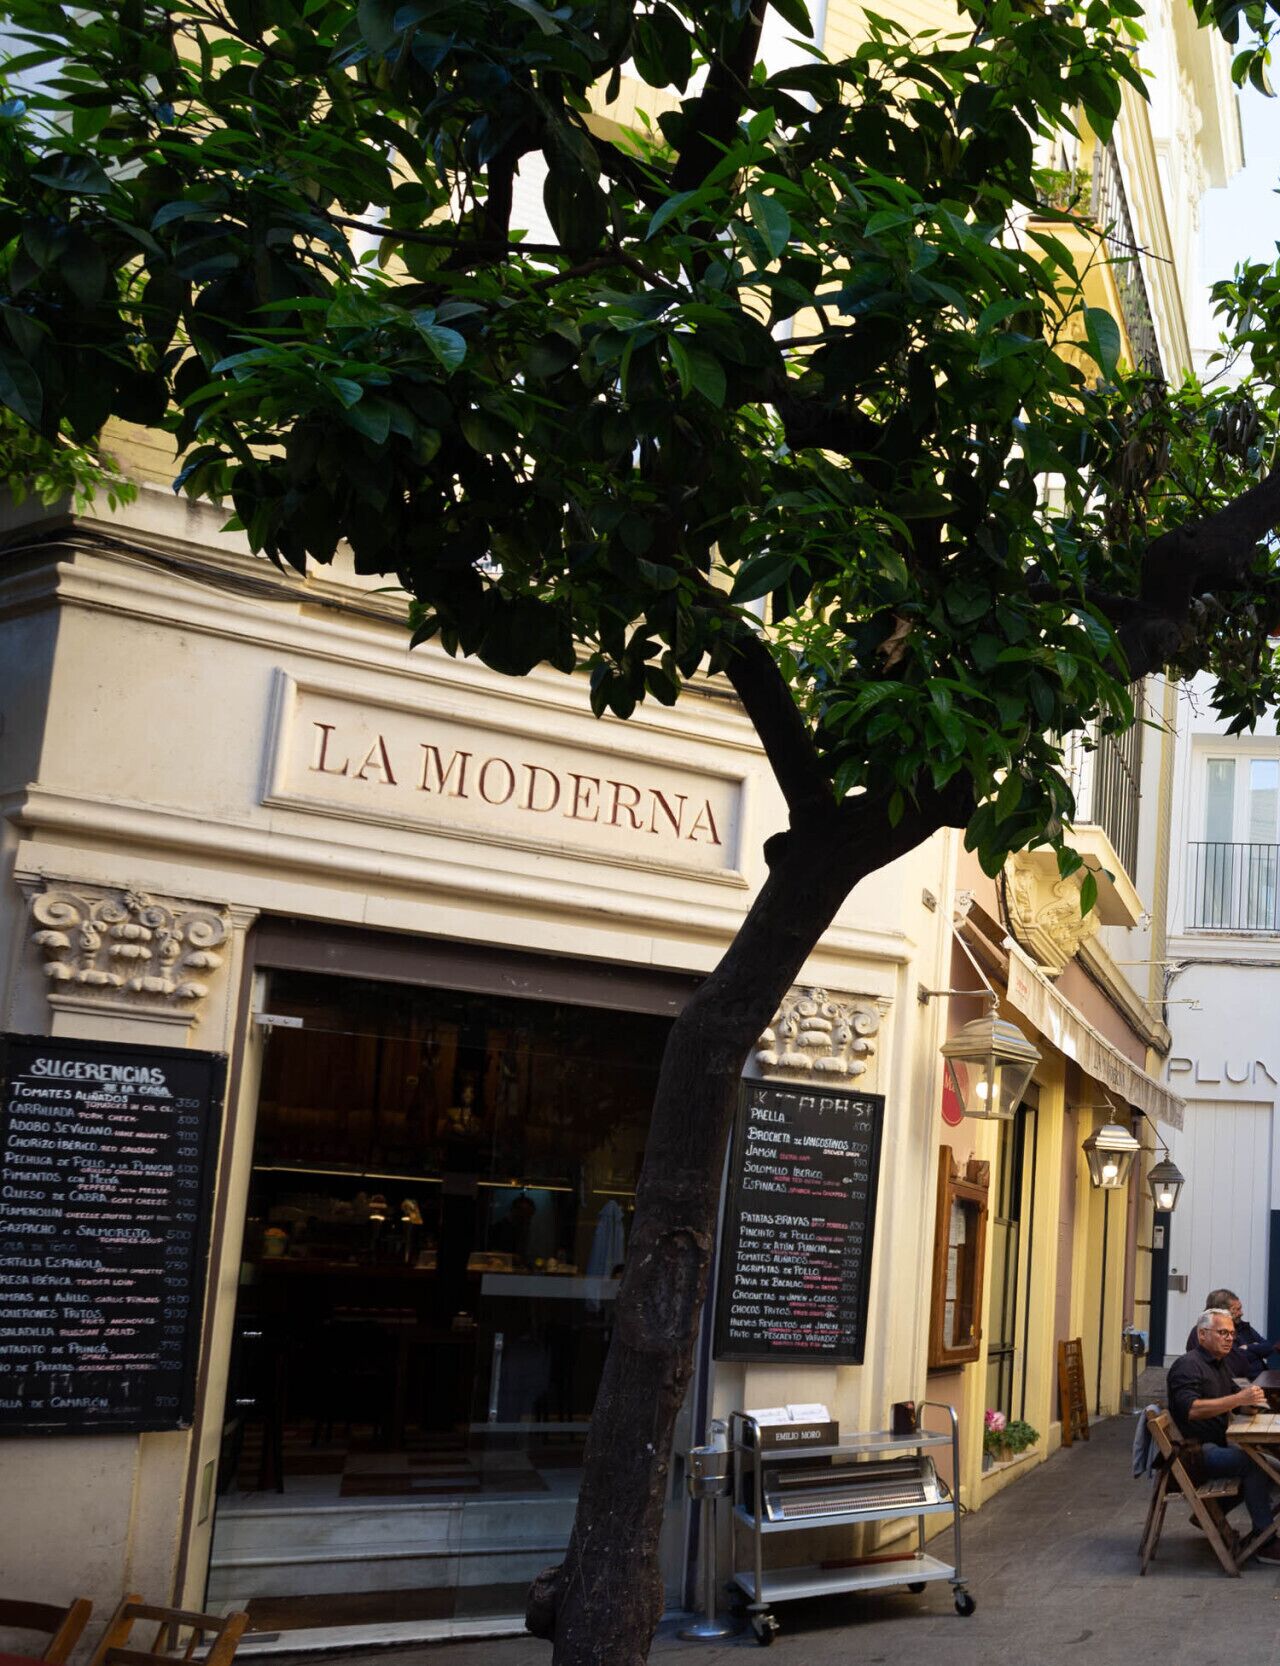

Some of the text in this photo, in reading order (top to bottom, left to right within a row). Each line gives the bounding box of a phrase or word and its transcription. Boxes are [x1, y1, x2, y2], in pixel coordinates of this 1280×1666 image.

[308, 721, 722, 846] LA MODERNA
[30, 1057, 166, 1086] SUGERENCIAS
[11, 1082, 73, 1100] TOMATES
[751, 1107, 786, 1123] PAELLA
[9, 1119, 51, 1133] ADOBO
[7, 1134, 56, 1150] CHORIZO
[747, 1126, 791, 1145] BROCHETA
[745, 1142, 777, 1159] JAMÓN
[4, 1151, 53, 1166] PECHUGA
[72, 1156, 105, 1169] POLLO
[2, 1168, 62, 1183] PIMIENTOS
[743, 1161, 788, 1177] SOLOMILLO
[1, 1185, 47, 1201] QUESO
[69, 1190, 107, 1203] CABRA
[740, 1211, 774, 1225] PATATAS
[775, 1215, 809, 1229] BRAVAS
[77, 1225, 150, 1239] SALMOREJO
[791, 1229, 816, 1242] POLLO
[738, 1238, 760, 1250] LOMO
[45, 1256, 103, 1269] ESPAÑOLA
[736, 1251, 771, 1263] TOMATES
[793, 1265, 820, 1277] POLLO
[63, 1307, 103, 1320] FRITOS
[775, 1429, 821, 1442] EMILIO MORO
